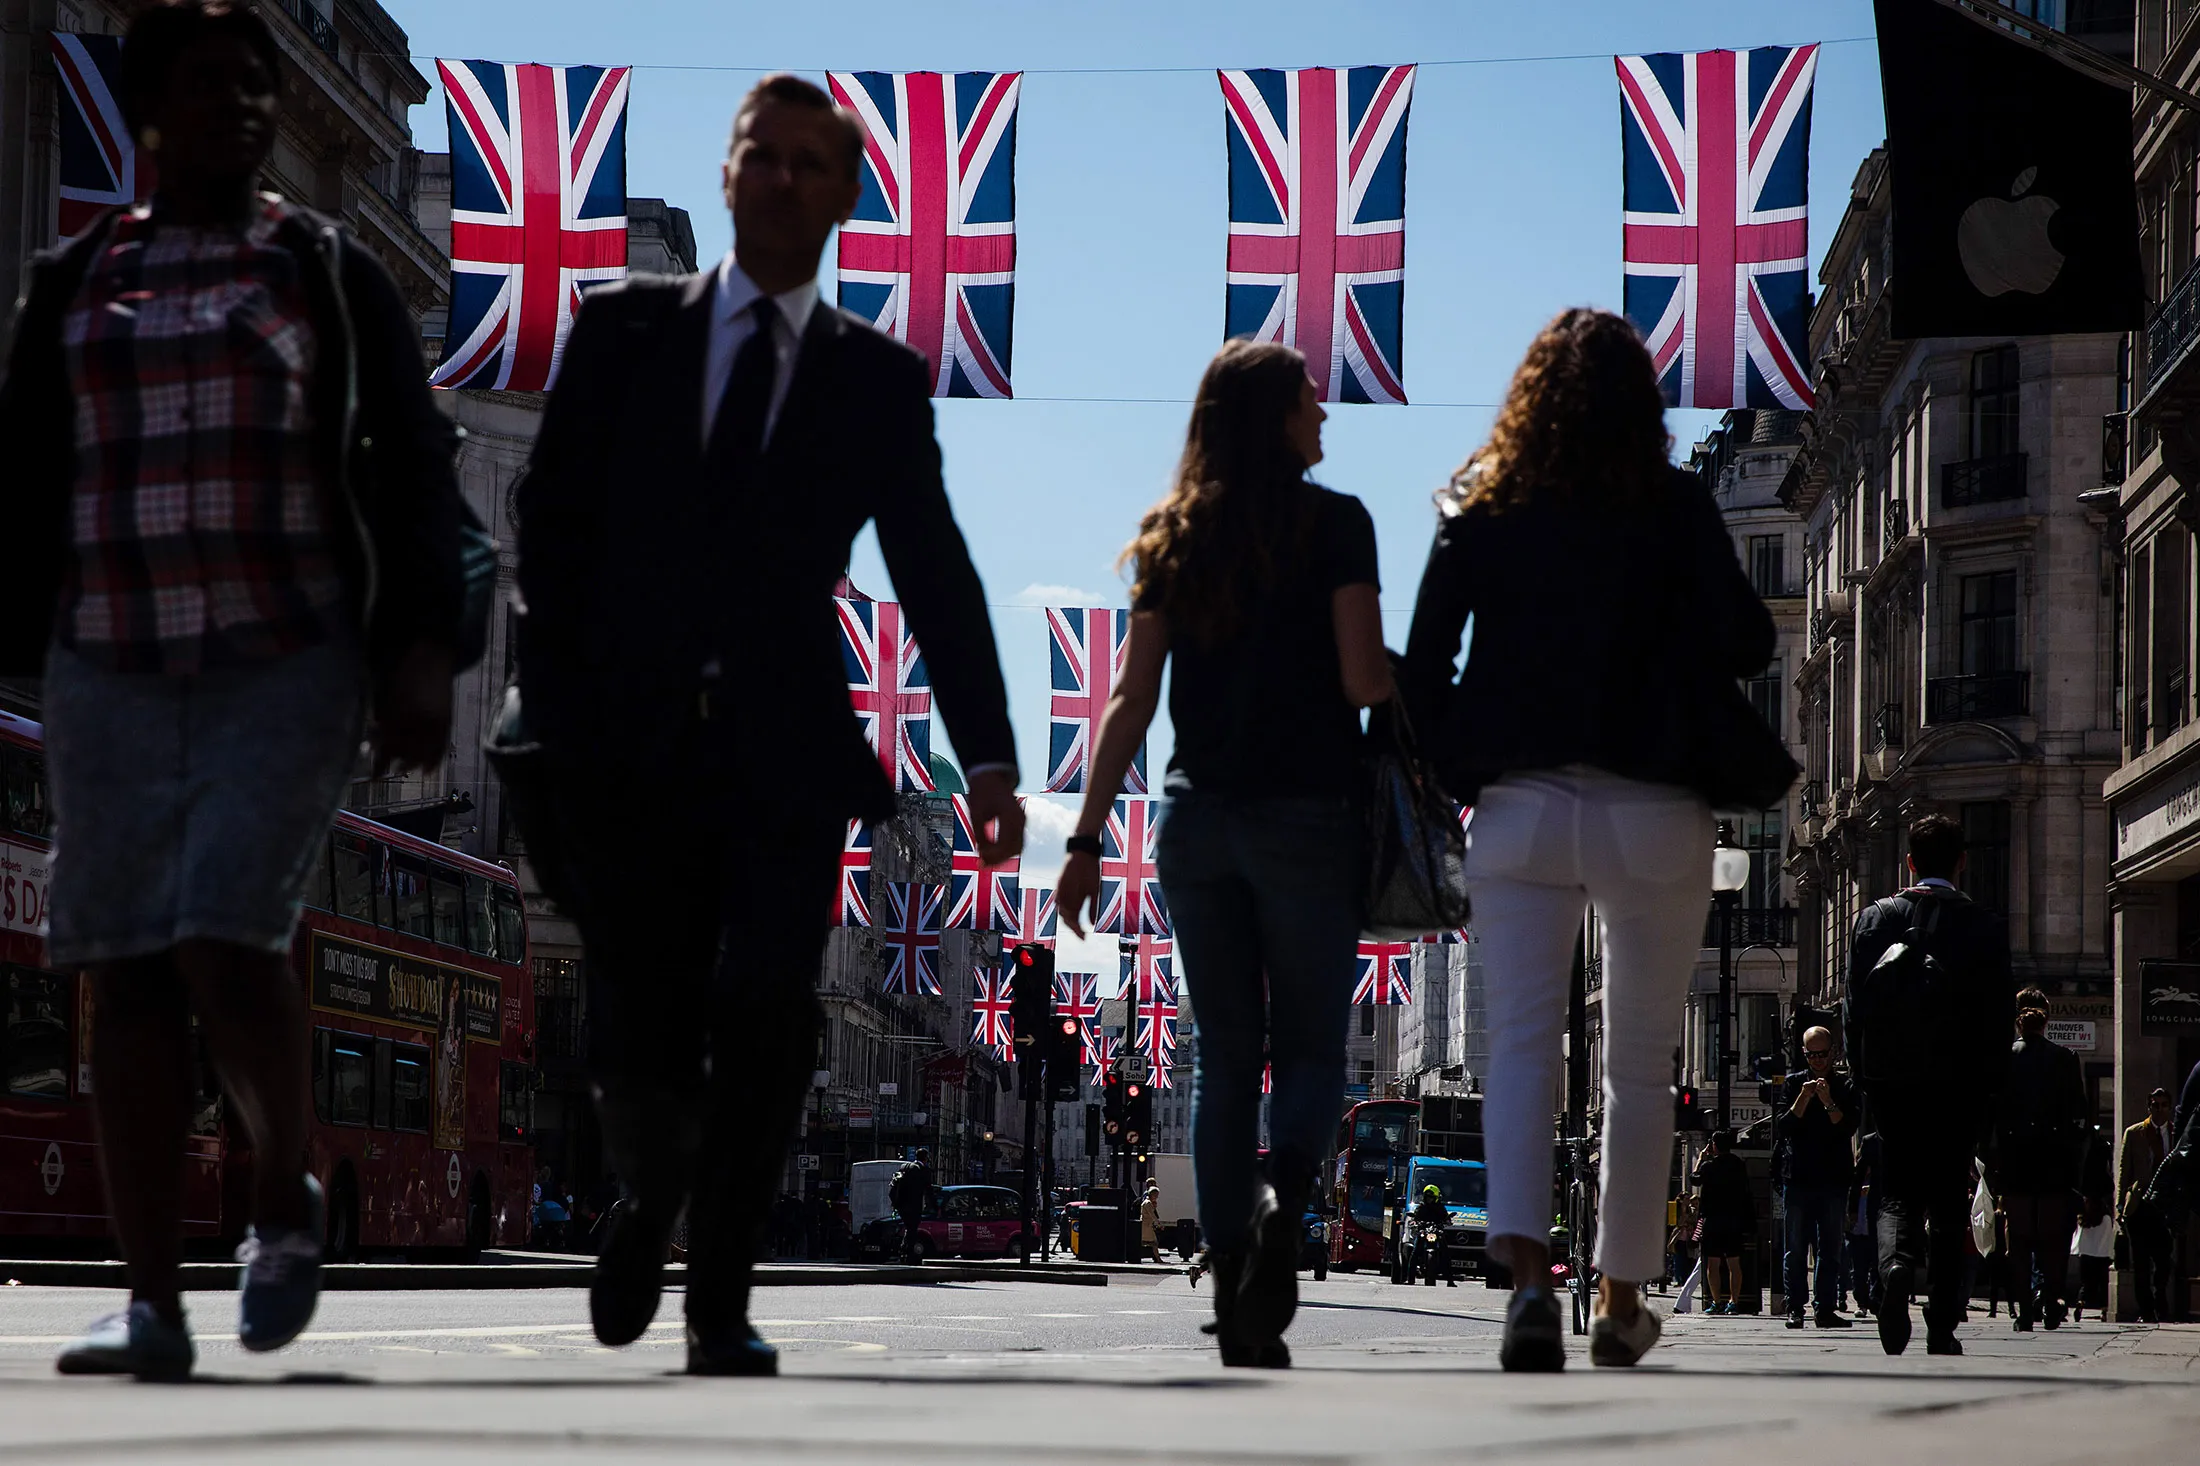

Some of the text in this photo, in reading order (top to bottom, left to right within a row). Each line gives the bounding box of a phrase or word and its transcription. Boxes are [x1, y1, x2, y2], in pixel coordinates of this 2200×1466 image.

[388, 962, 446, 1022] SHOWBOAT
[2047, 1023, 2084, 1032] HANOVER
[2047, 1032, 2091, 1041] STREET W1
[1132, 1060, 1140, 1070] P
[1125, 1072, 1145, 1081] Soho
